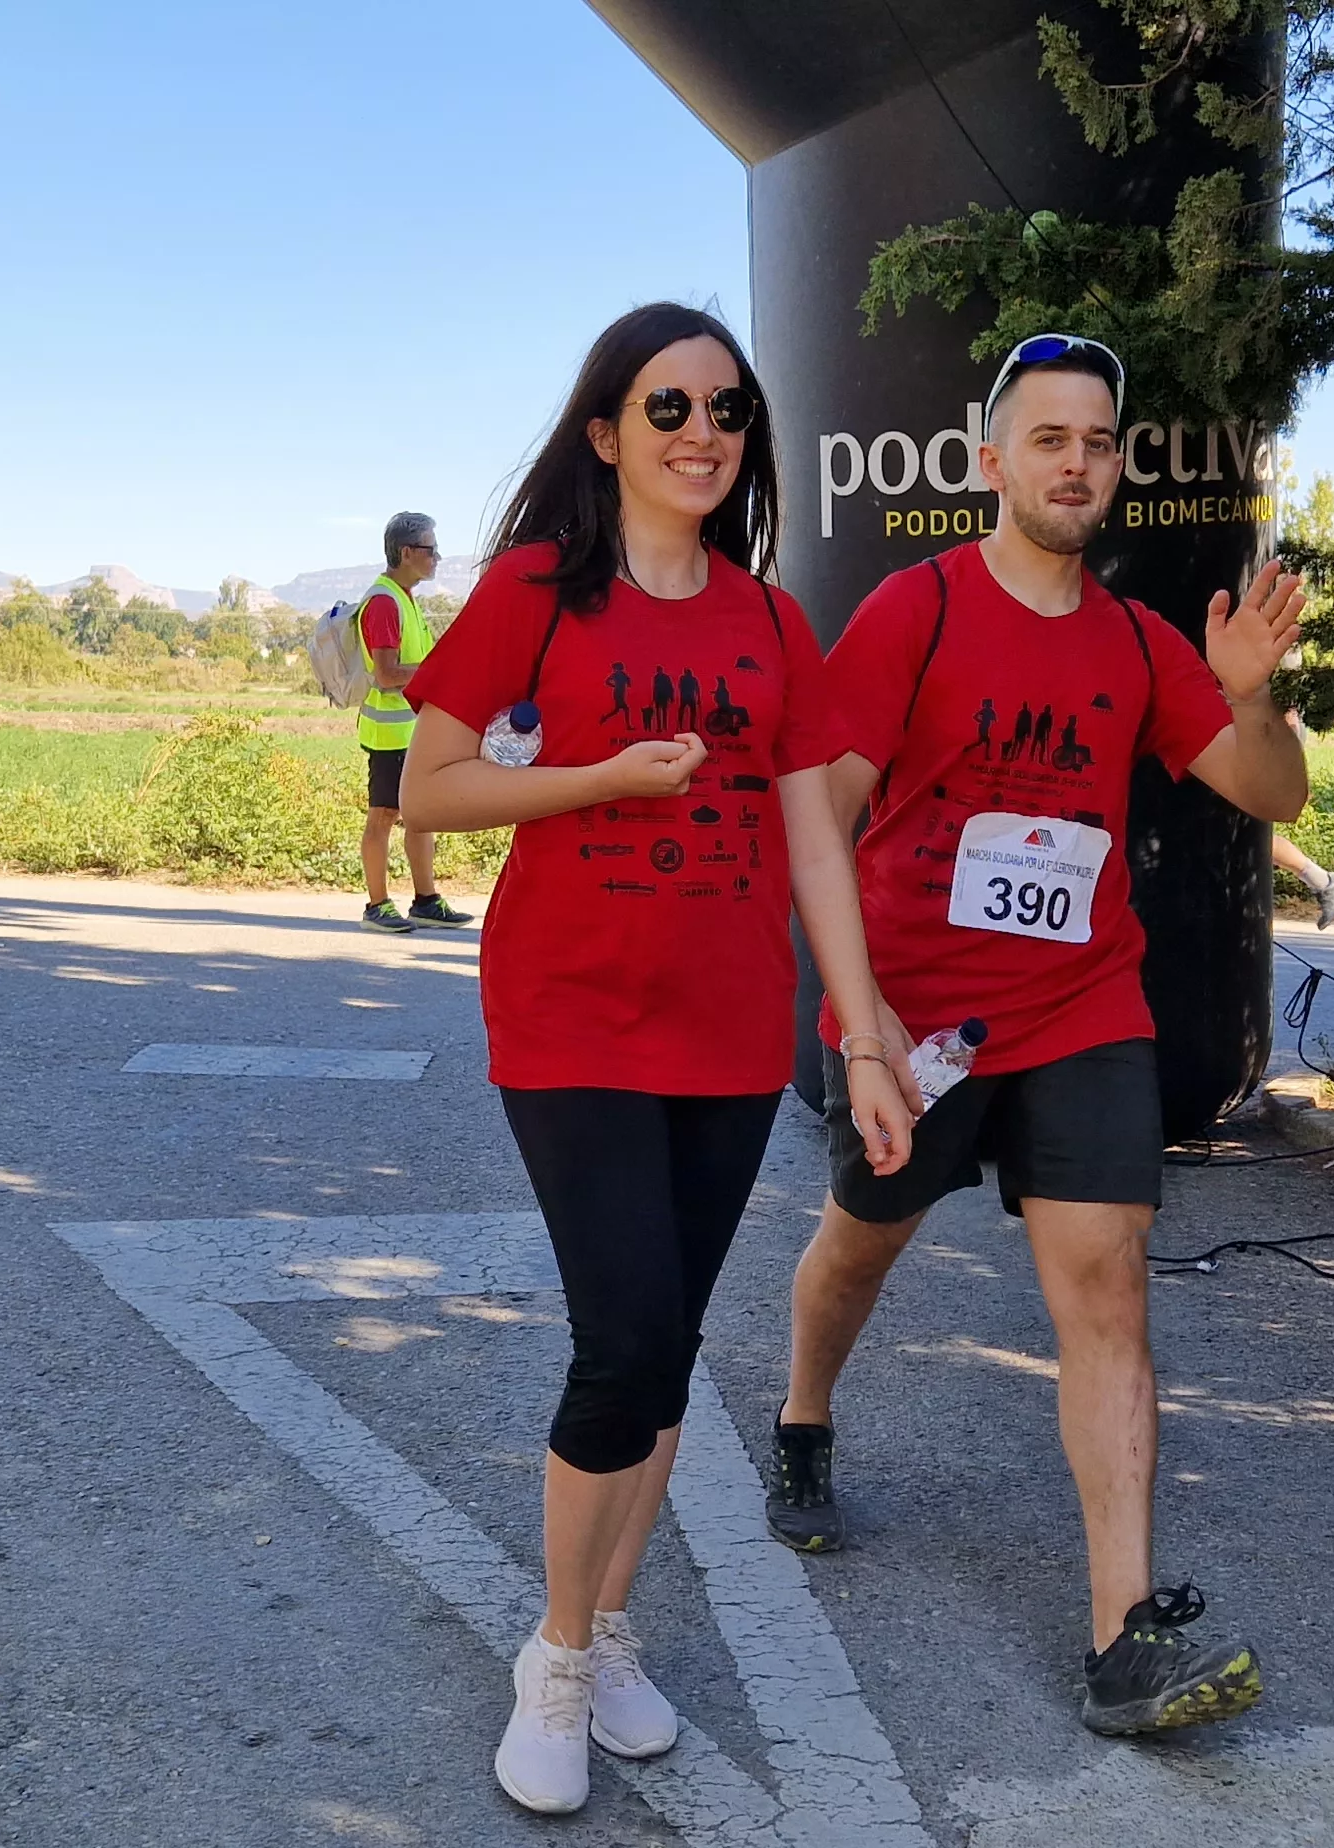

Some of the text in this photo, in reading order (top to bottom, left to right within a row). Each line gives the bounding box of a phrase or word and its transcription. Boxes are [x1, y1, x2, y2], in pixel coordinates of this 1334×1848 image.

[1126, 490, 1275, 528] BIOMECÁNICA
[966, 847, 992, 862] MARCHA
[992, 850, 1024, 867] SOLIDARIA
[1024, 856, 1038, 869] POR
[983, 876, 1071, 931] 390
